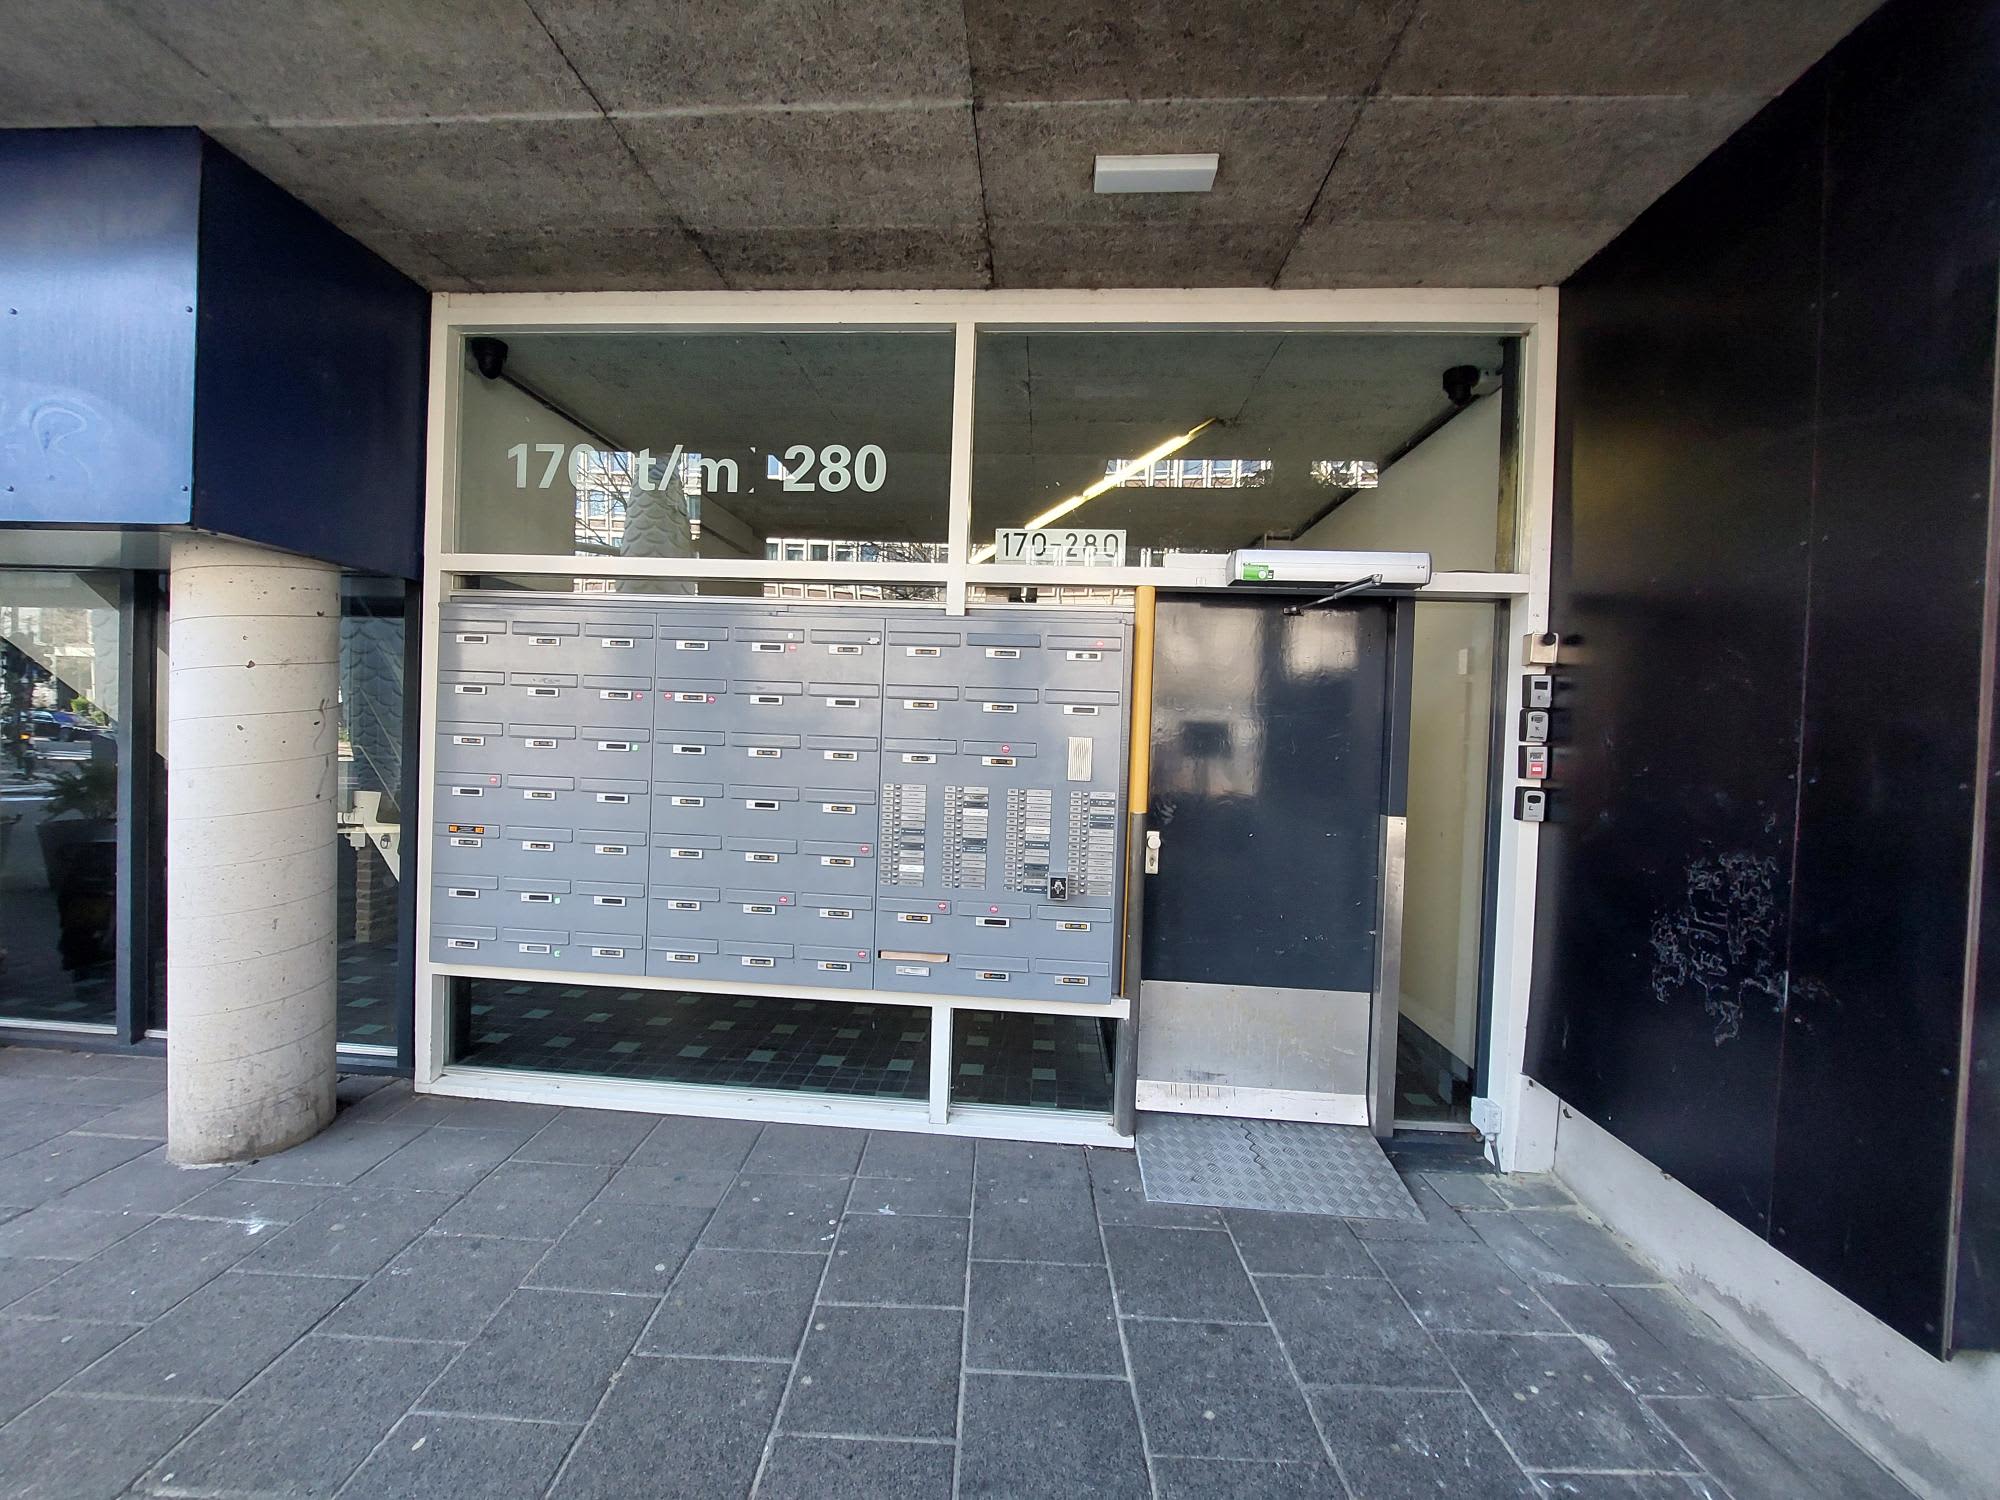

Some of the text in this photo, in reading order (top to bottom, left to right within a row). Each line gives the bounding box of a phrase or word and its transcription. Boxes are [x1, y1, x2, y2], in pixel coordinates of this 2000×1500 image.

[635, 444, 739, 493] t/m
[783, 444, 887, 492] 280
[1002, 532, 1119, 558] 170-280
